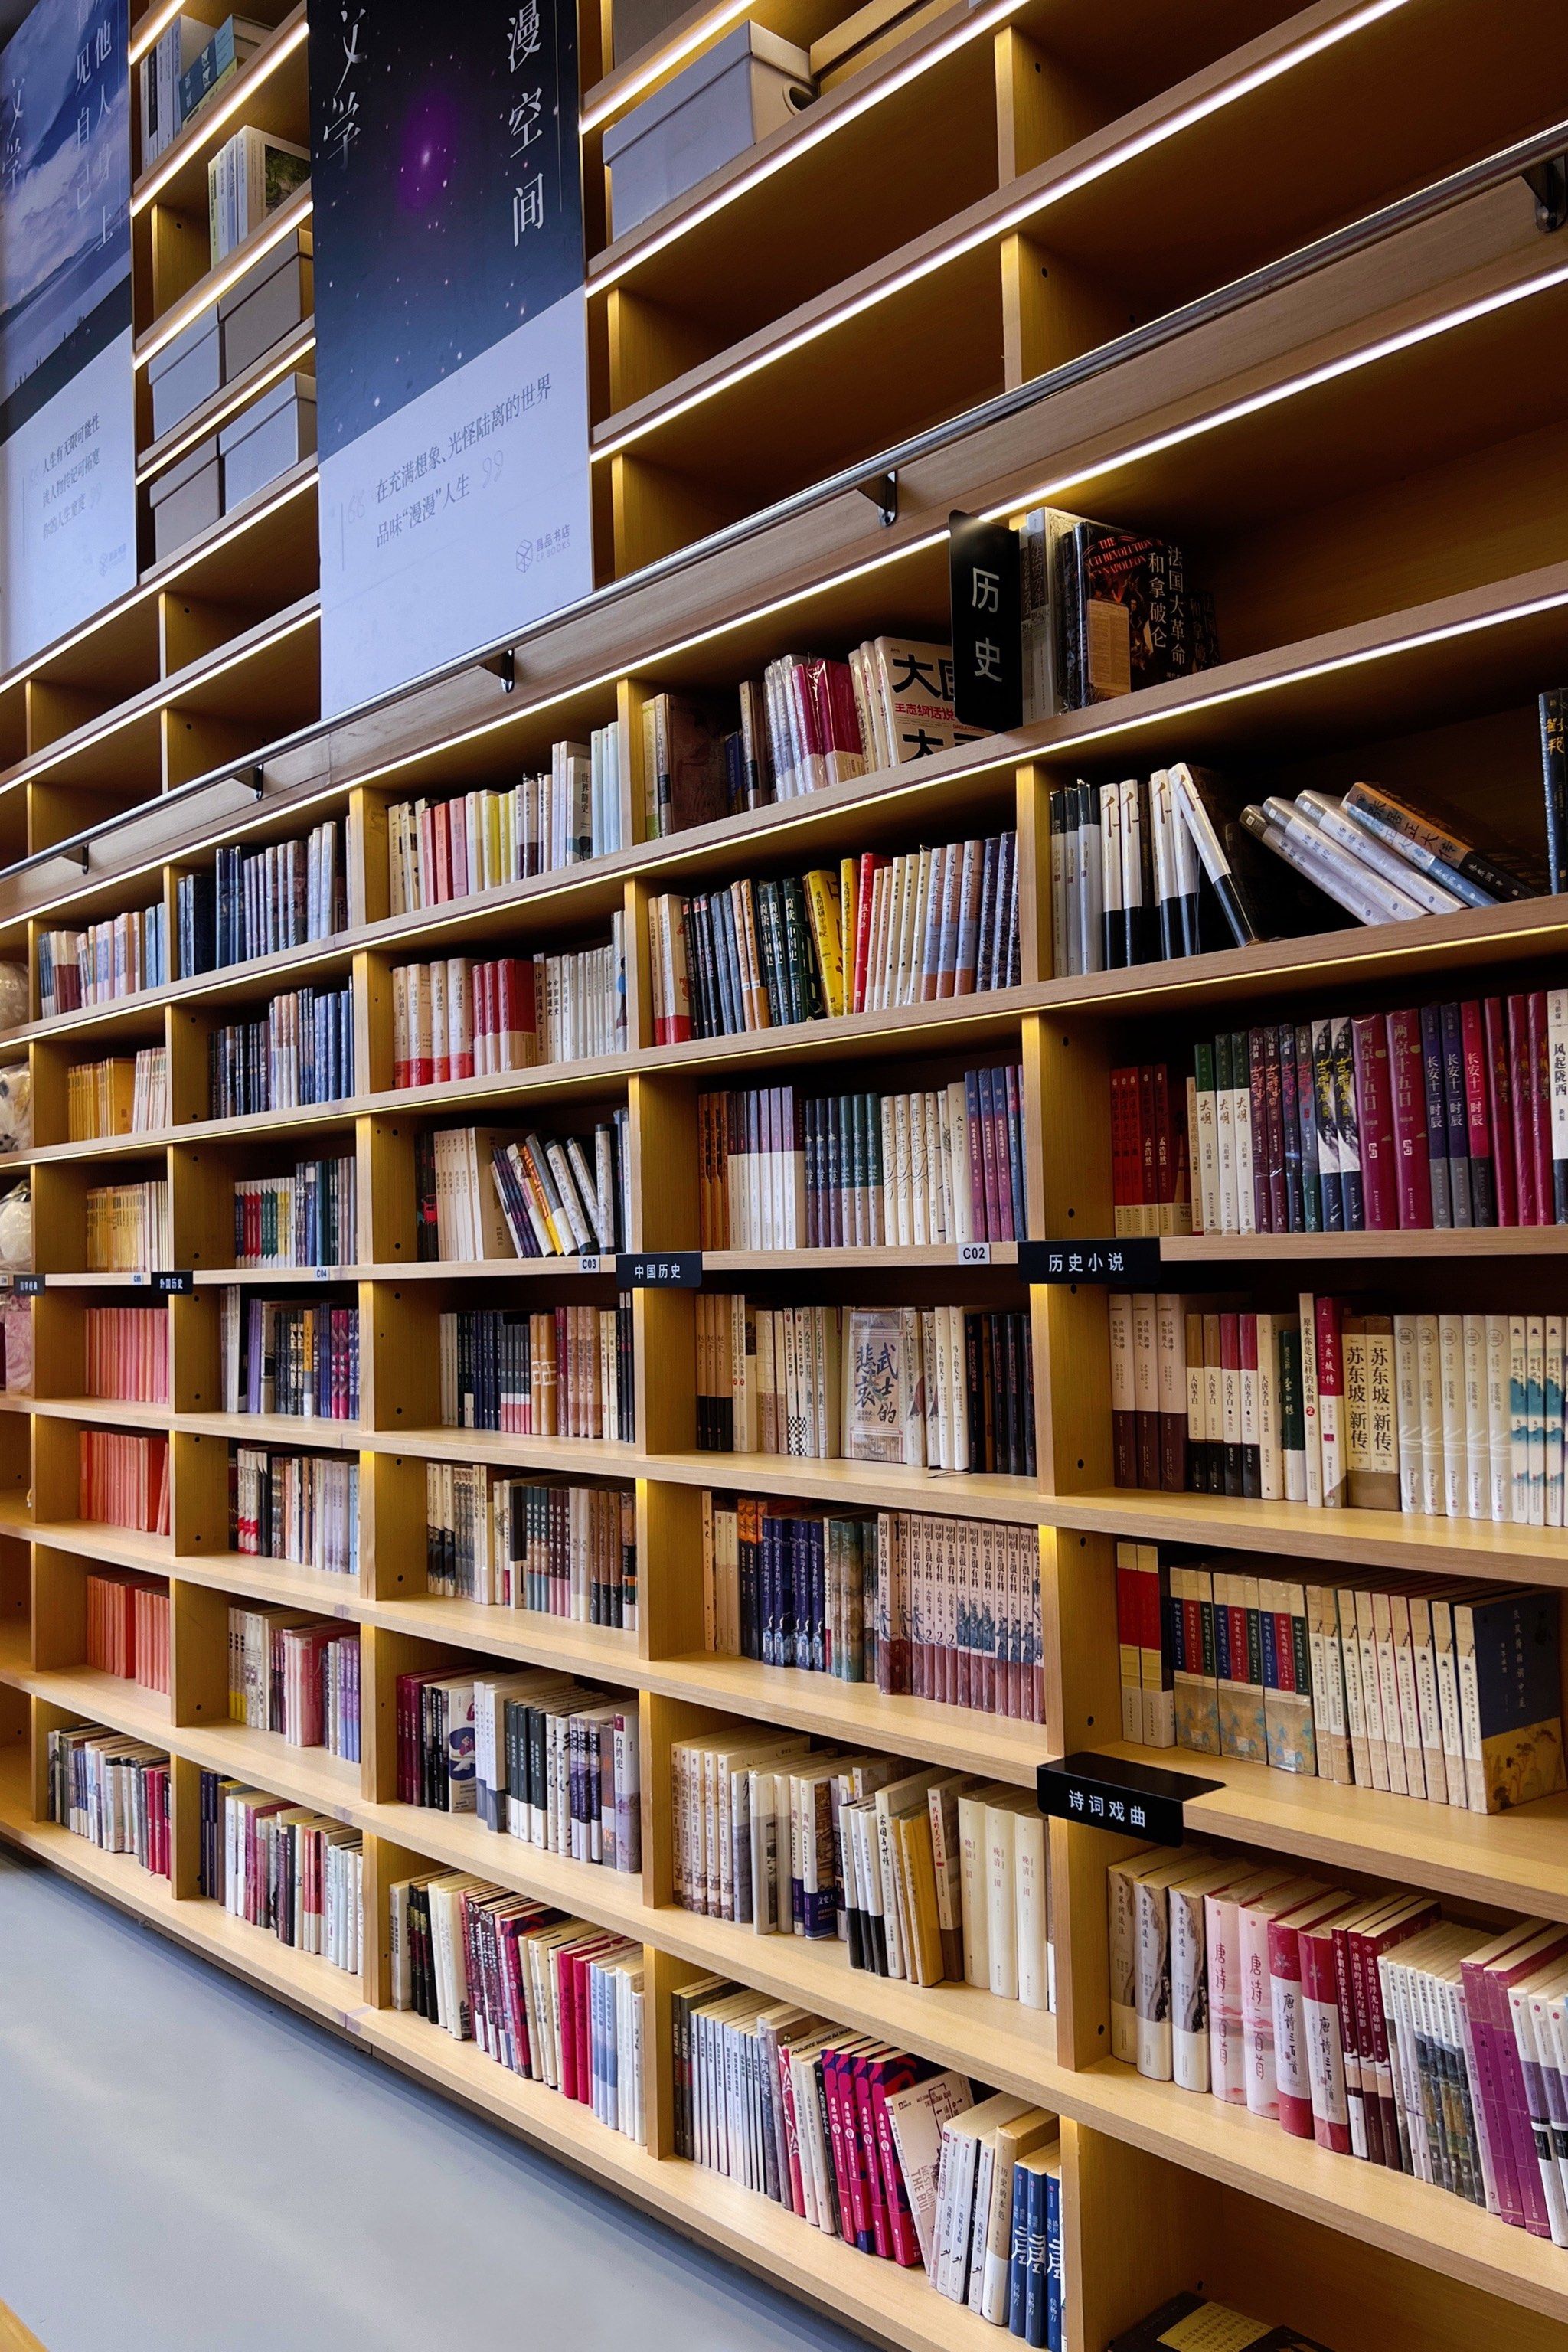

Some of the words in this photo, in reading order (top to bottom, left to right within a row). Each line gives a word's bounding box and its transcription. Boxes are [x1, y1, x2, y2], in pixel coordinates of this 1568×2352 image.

[323, 8, 368, 170] 文学
[43, 413, 100, 477] 人生有无限可能性
[374, 373, 552, 504] 在充满想象、光怪陆离的世界
[376, 473, 471, 548] 品味“漫漫”人生
[1098, 536, 1118, 550] THE
[1148, 552, 1168, 648] 和拿破仑
[1168, 545, 1185, 665] 法国大革命
[970, 567, 1003, 683] 历史
[894, 702, 956, 722] 王志纲话说
[1426, 1055, 1442, 1129] 长安十二时辰
[1467, 1051, 1484, 1127] 长安十二时辰
[1553, 1042, 1568, 1097] 风起陇西
[882, 1109, 893, 1155] 唐玄宗
[896, 1109, 906, 1155] 唐玄宗
[910, 1109, 920, 1155] 唐玄宗
[1199, 1099, 1212, 1125] 大明
[1219, 1099, 1231, 1125] 大明
[1236, 1096, 1249, 1124] 大明
[316, 1269, 328, 1279] C04
[582, 1259, 597, 1270] C03
[634, 1263, 681, 1279] 中国历史
[963, 1247, 986, 1259] C02
[1047, 1252, 1125, 1272] 历史小说
[159, 1278, 184, 1289] 外国历史
[854, 1342, 877, 1409] 悲哀
[877, 1341, 899, 1424] 武士的
[1303, 1317, 1315, 1404] 原来你是这样的宋朝
[1325, 1334, 1336, 1387] 苏东坡传
[1346, 1345, 1367, 1403] 苏东坡
[1370, 1347, 1390, 1405] 苏东坡
[1349, 1410, 1369, 1449] 新传
[1373, 1412, 1393, 1452] 新传
[926, 1628, 933, 1640] 2
[937, 1631, 944, 1643] 2
[948, 1634, 955, 1645] 2
[615, 1736, 625, 1770] 台湾史
[1068, 1789, 1146, 1828] 诗词戏曲
[1214, 1942, 1227, 2066] 唐诗三百首
[1249, 1952, 1266, 2081] 唐诗三百首
[1282, 1993, 1298, 2076] 唐诗三百首
[1318, 2016, 1336, 2102] 唐诗三百首
